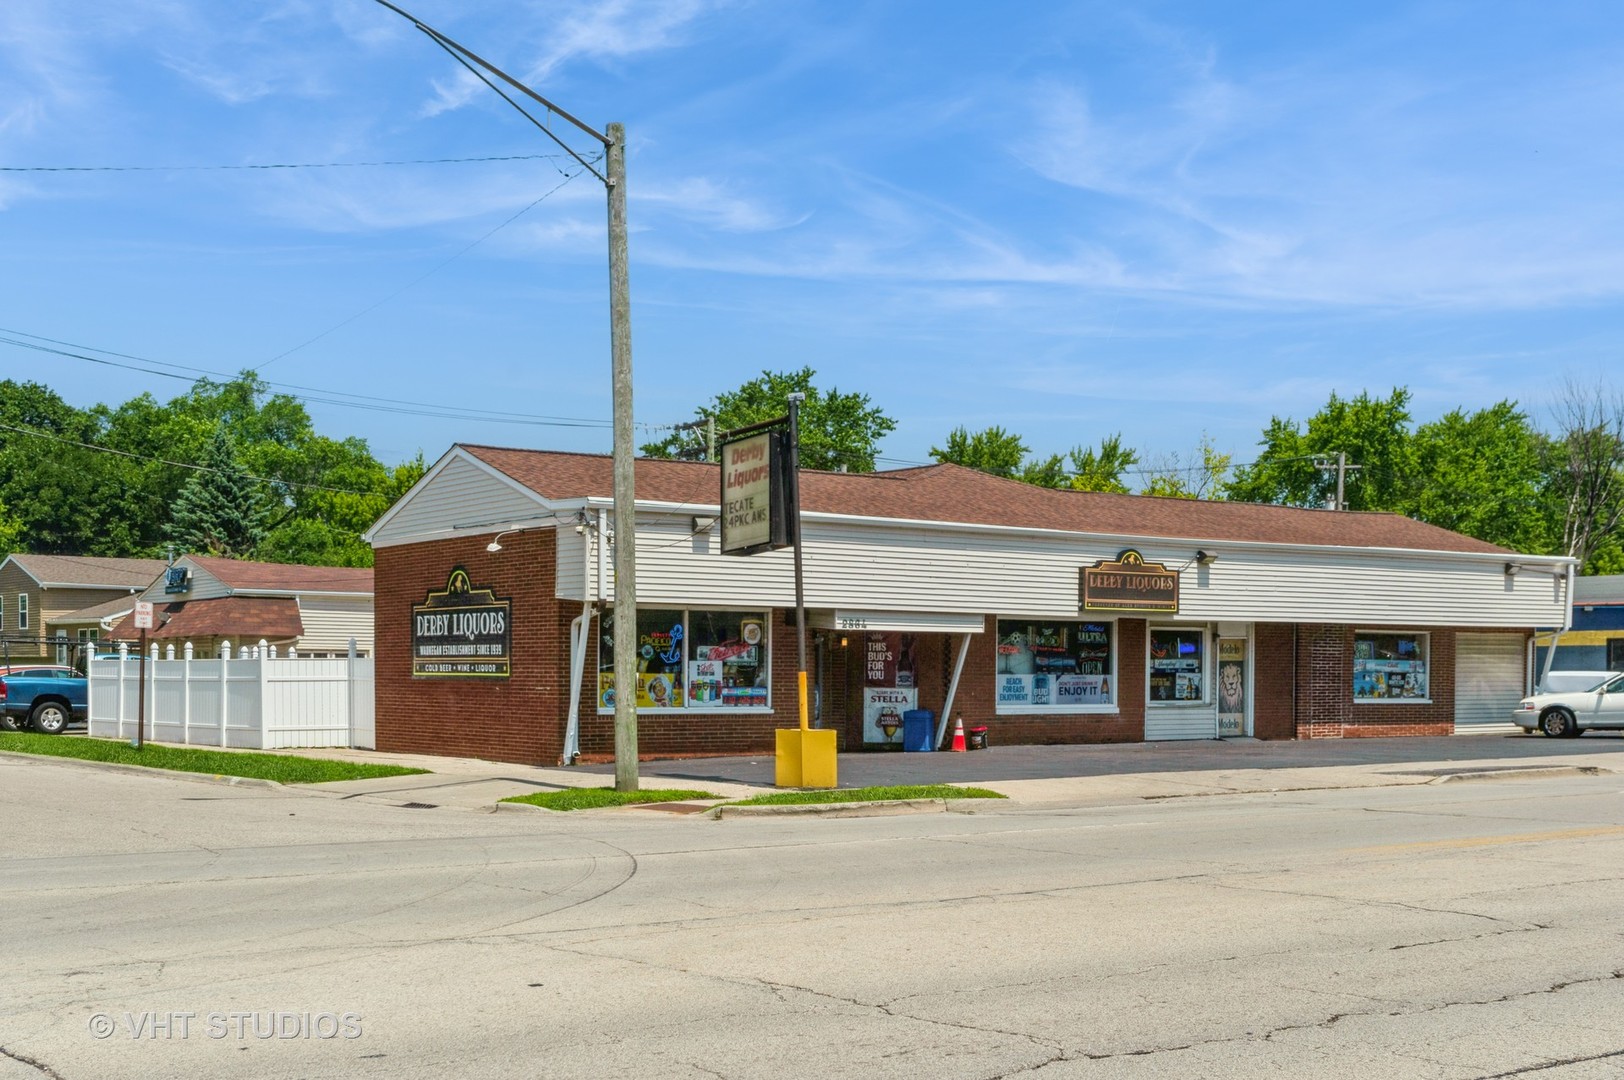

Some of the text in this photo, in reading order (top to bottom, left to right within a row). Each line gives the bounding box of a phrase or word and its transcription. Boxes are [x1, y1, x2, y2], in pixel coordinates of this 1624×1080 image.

[732, 443, 766, 466] Derby
[726, 464, 769, 488] Liquors
[724, 497, 754, 514] TECATE
[1089, 574, 1174, 592] DERBY LIQUORS
[416, 612, 505, 640] DERBY LIQUORS
[1078, 632, 1107, 642] ULTRA
[443, 644, 476, 655] ESTABLISHMENT
[477, 644, 490, 655] SINCE
[867, 642, 887, 652] THIS
[867, 652, 893, 661] BUD'S
[867, 661, 884, 670] FOR
[867, 670, 884, 680] YOU
[1058, 686, 1098, 696] ENJOY IT
[870, 695, 908, 704] STELLA
